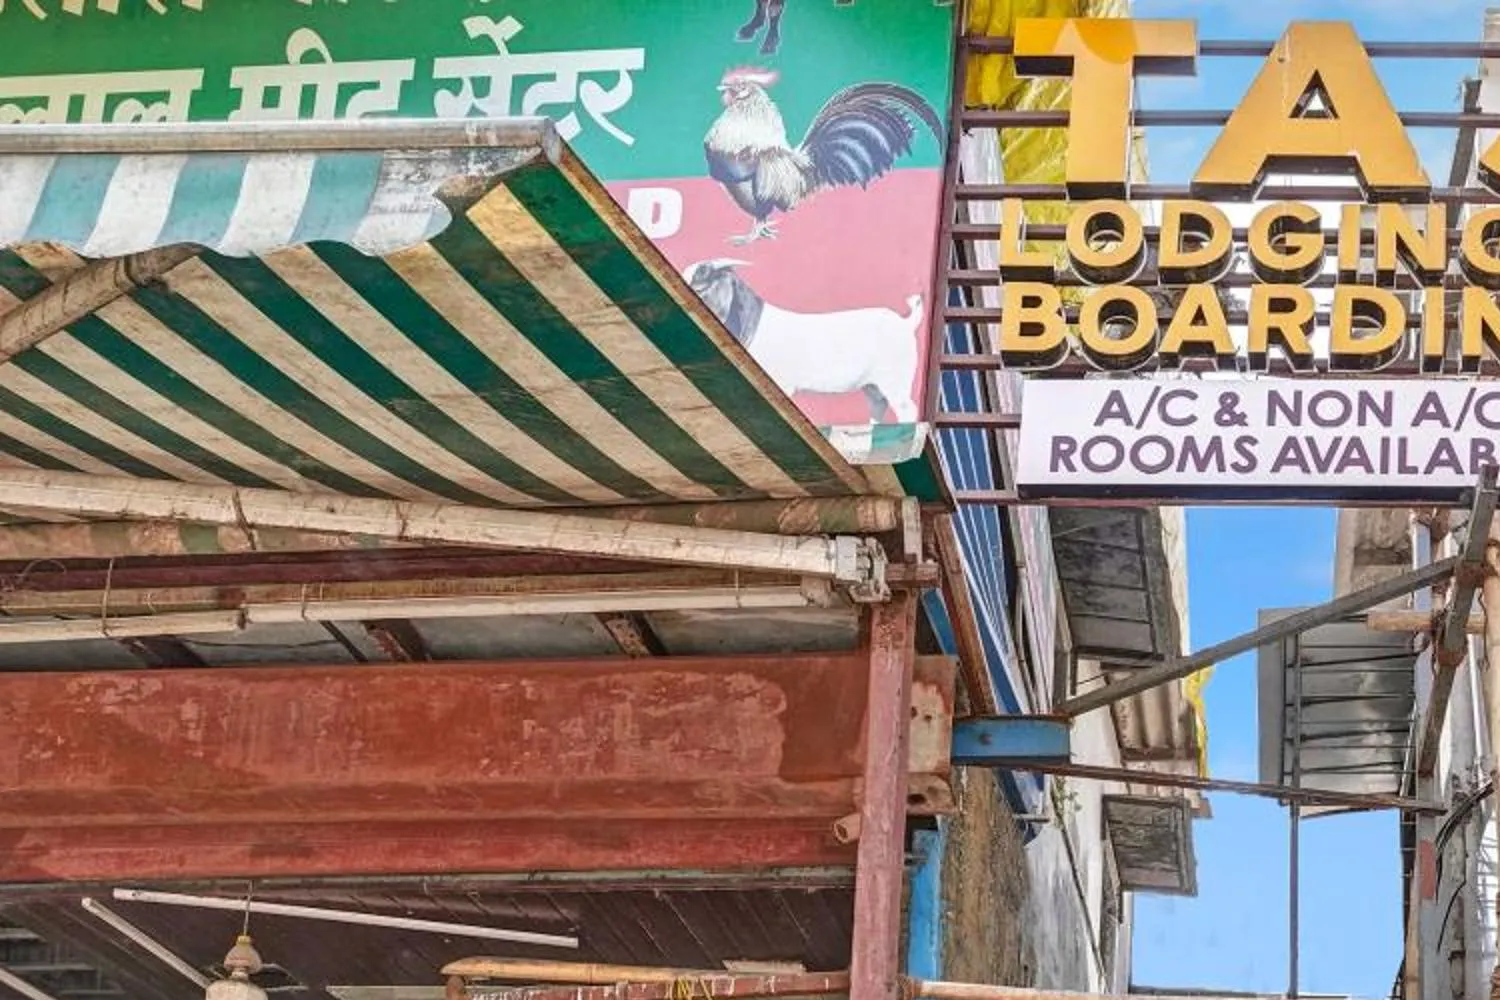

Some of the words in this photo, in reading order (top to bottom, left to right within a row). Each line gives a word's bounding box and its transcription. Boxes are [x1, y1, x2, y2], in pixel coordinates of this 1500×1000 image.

[1094, 386, 1198, 429] A/C
[1214, 391, 1248, 427] &
[1267, 391, 1393, 427] NON
[1049, 435, 1258, 474] ROOMS
